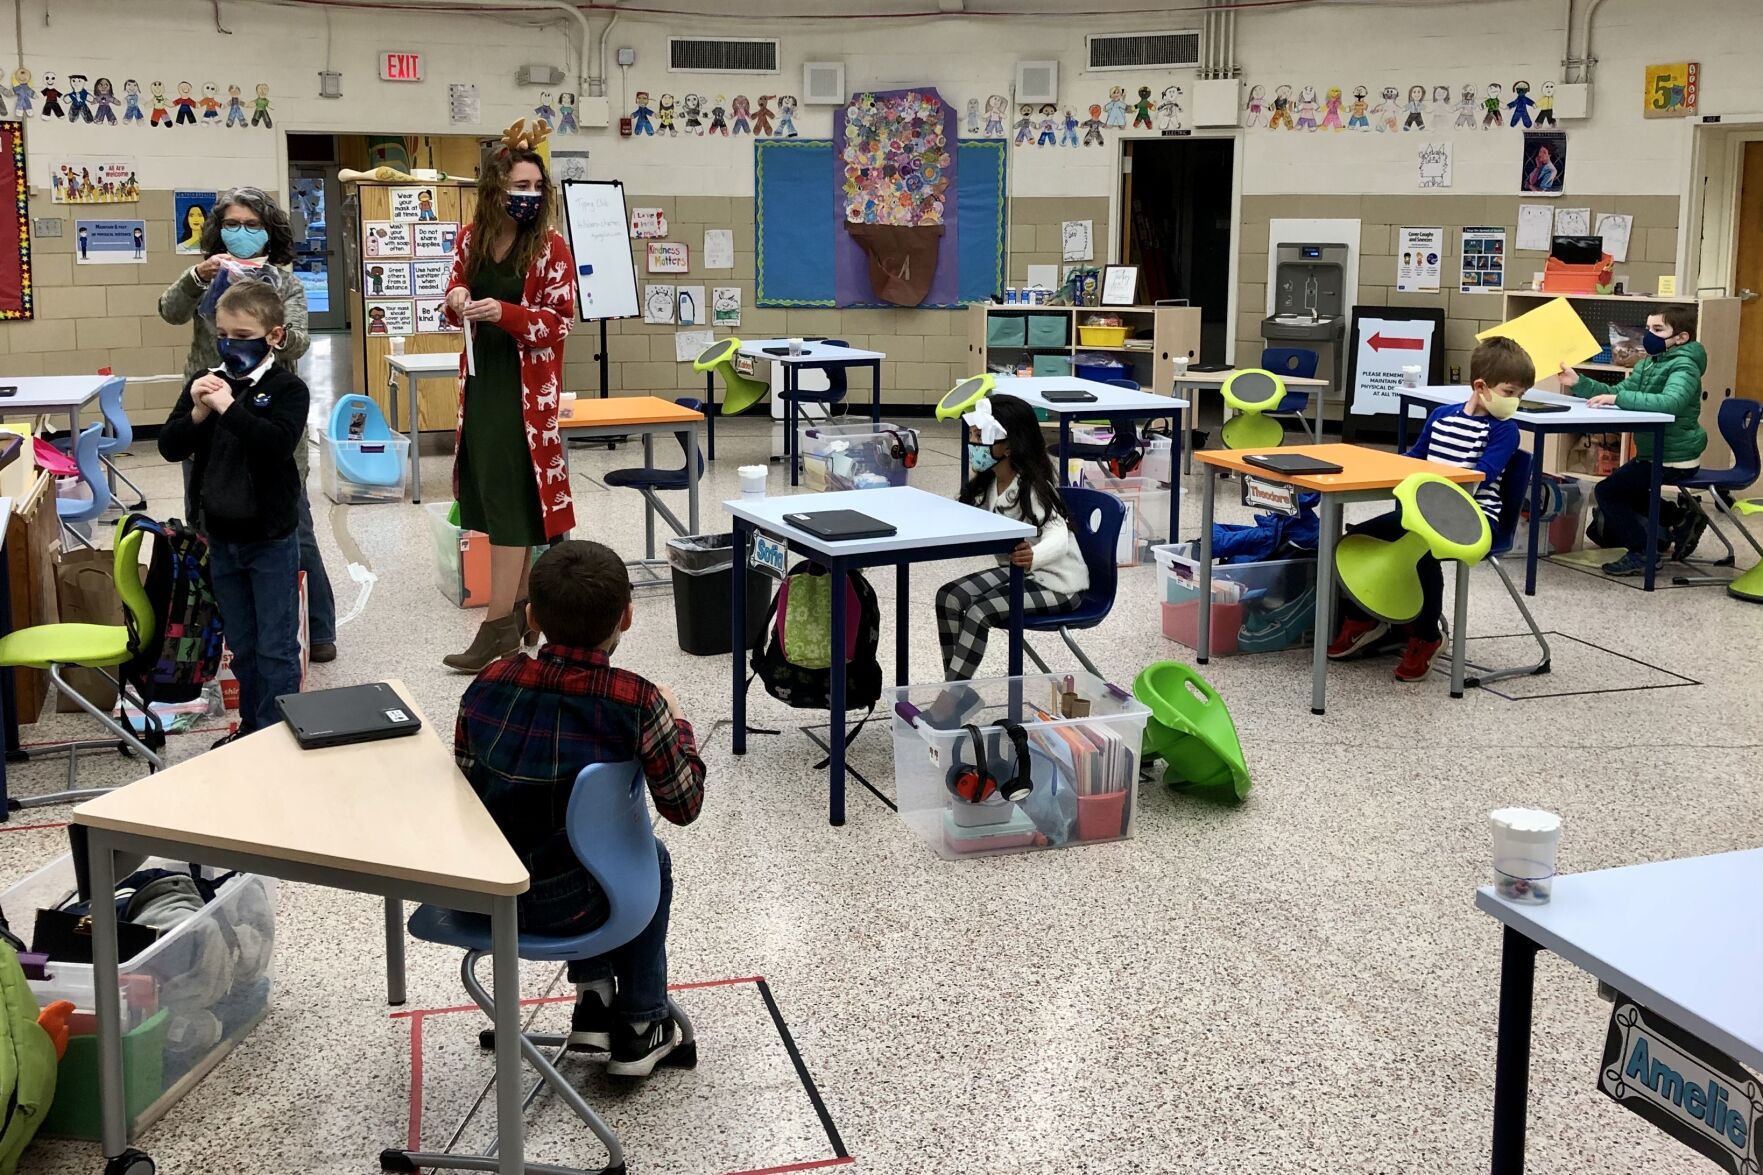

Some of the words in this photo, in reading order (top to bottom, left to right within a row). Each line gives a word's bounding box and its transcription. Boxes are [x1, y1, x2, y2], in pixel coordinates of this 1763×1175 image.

[387, 53, 418, 78] EXIT
[649, 244, 680, 255] Kindness
[655, 256, 686, 267] Matters
[1251, 486, 1290, 504] Theodore
[756, 538, 783, 568] Sofia
[1626, 1036, 1748, 1149] Amelie
